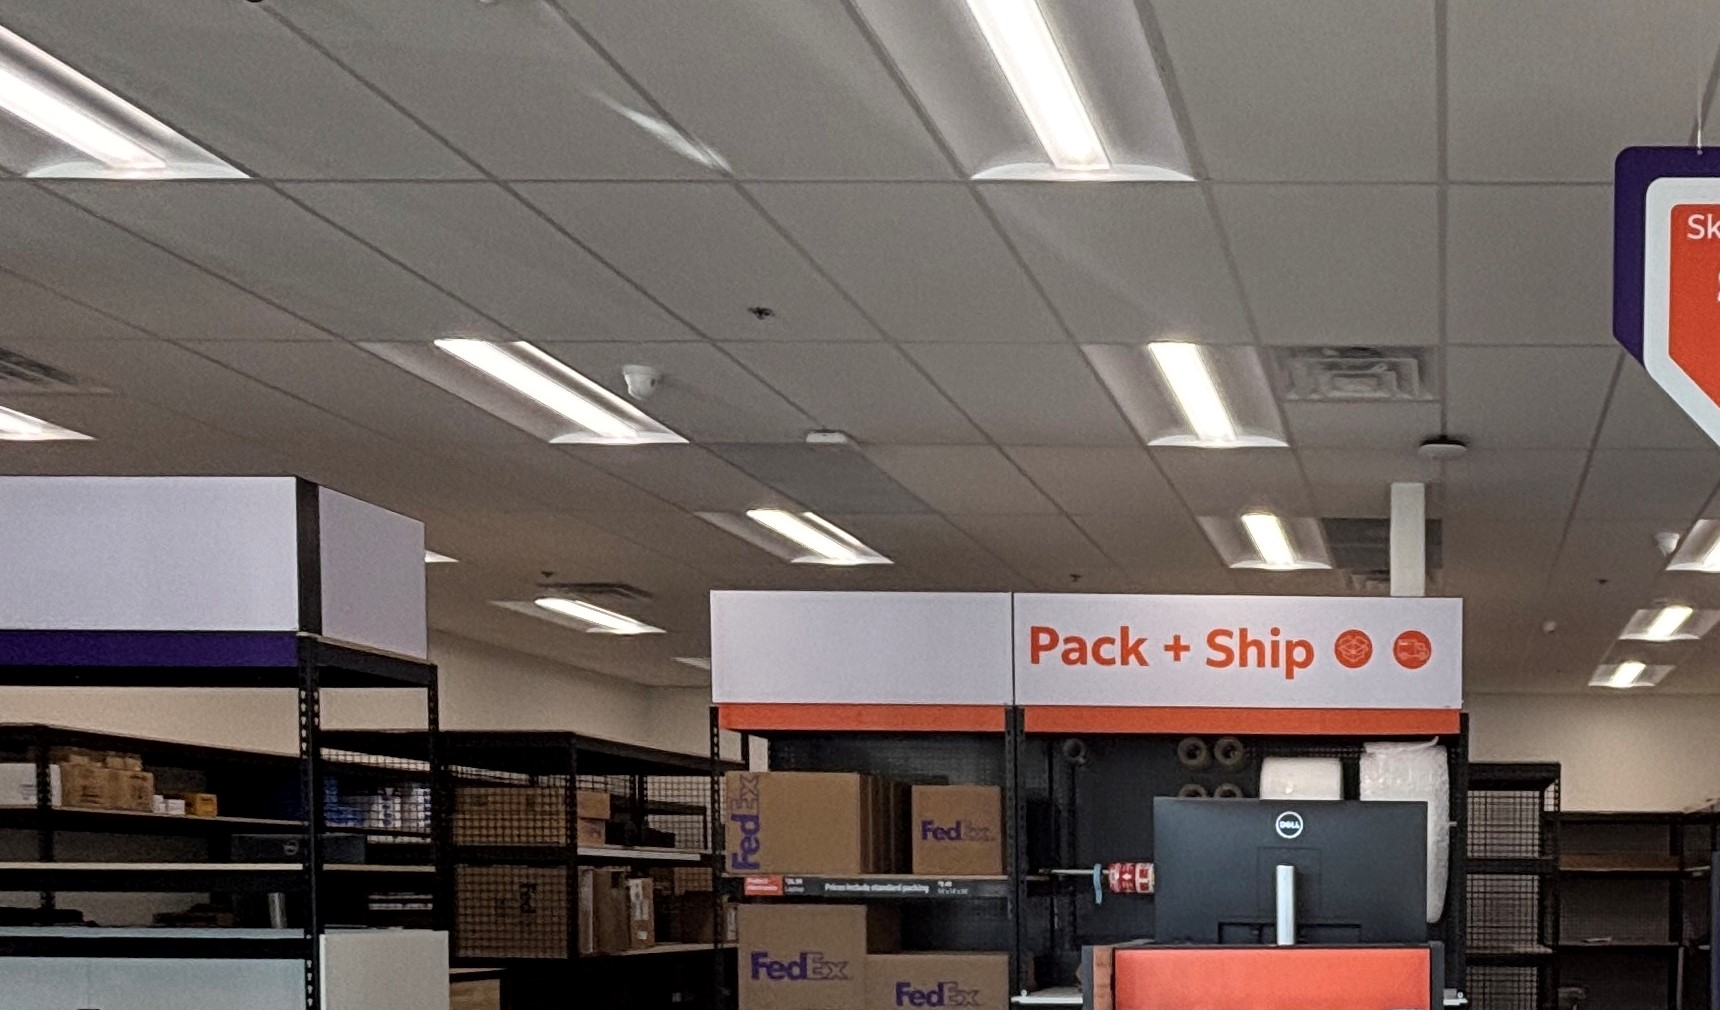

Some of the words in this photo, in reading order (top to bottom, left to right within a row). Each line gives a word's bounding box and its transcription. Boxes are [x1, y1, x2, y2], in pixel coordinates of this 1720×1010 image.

[1030, 626, 1149, 667] Pack
[1164, 634, 1190, 662] +
[1206, 627, 1315, 680] Ship
[731, 774, 760, 870] FedEx
[921, 820, 998, 842] FedEx
[824, 882, 846, 892] Prices
[871, 883, 901, 892] standard
[902, 883, 929, 894] packing
[750, 951, 850, 981] FedEx
[895, 981, 982, 1008] FedEx
